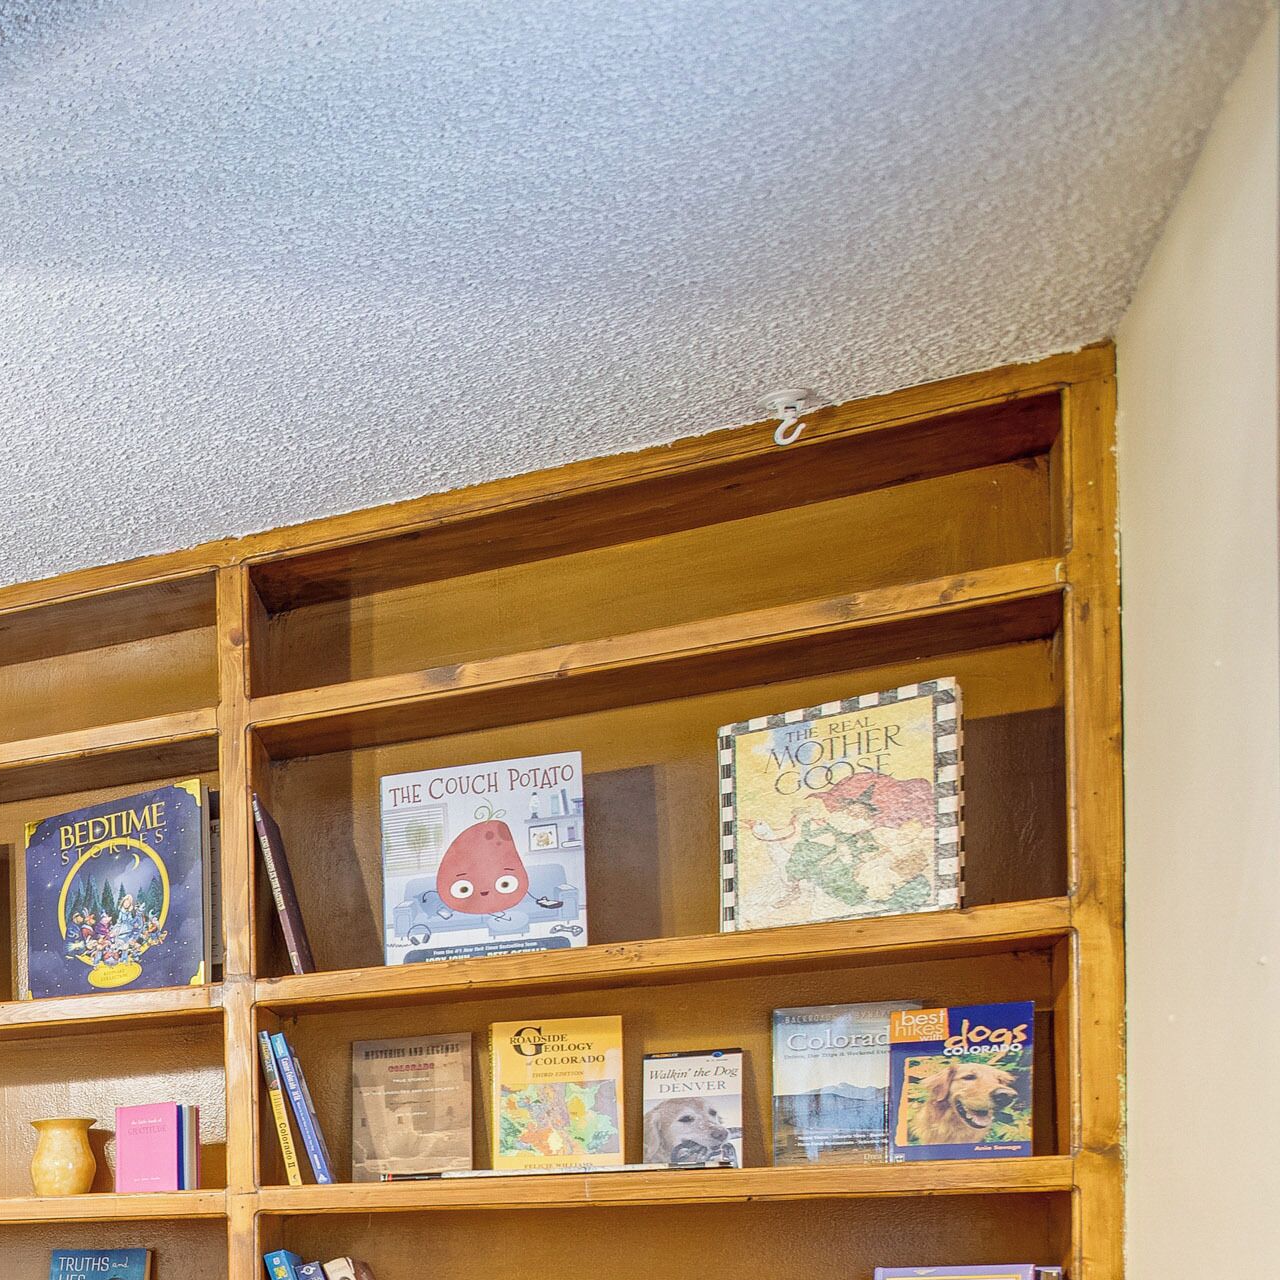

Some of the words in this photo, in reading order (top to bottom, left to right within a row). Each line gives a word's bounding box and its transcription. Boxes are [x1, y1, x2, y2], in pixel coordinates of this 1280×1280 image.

[785, 727, 818, 743] THE
[830, 716, 877, 734] REAL
[765, 723, 903, 774] MOTHER
[775, 753, 894, 795] GOOSE
[389, 784, 422, 807] THE
[429, 771, 498, 799] COUCH
[60, 802, 166, 850] BEDTIME
[61, 828, 166, 866] STORIES
[895, 1020, 944, 1037] hikes
[901, 1011, 945, 1026] best
[510, 1034, 568, 1045] ROADSIDE
[513, 1026, 593, 1056] GEOLOGY
[787, 1025, 890, 1051] Colorad
[920, 1033, 943, 1042] with
[944, 1019, 1028, 1065] dogs
[364, 1048, 406, 1060] MYSTERIES
[409, 1047, 423, 1056] AND
[426, 1043, 460, 1056] LEGENDS
[943, 1043, 1023, 1056] COLORADO
[388, 1062, 435, 1073] COLORADO
[650, 1068, 691, 1081] Walkin'
[694, 1067, 711, 1077] the
[714, 1065, 739, 1078] Dog
[659, 1081, 727, 1093] DENVER
[278, 1122, 293, 1161] Colorado
[58, 1256, 110, 1272] TRUTHS
[112, 1257, 129, 1268] and
